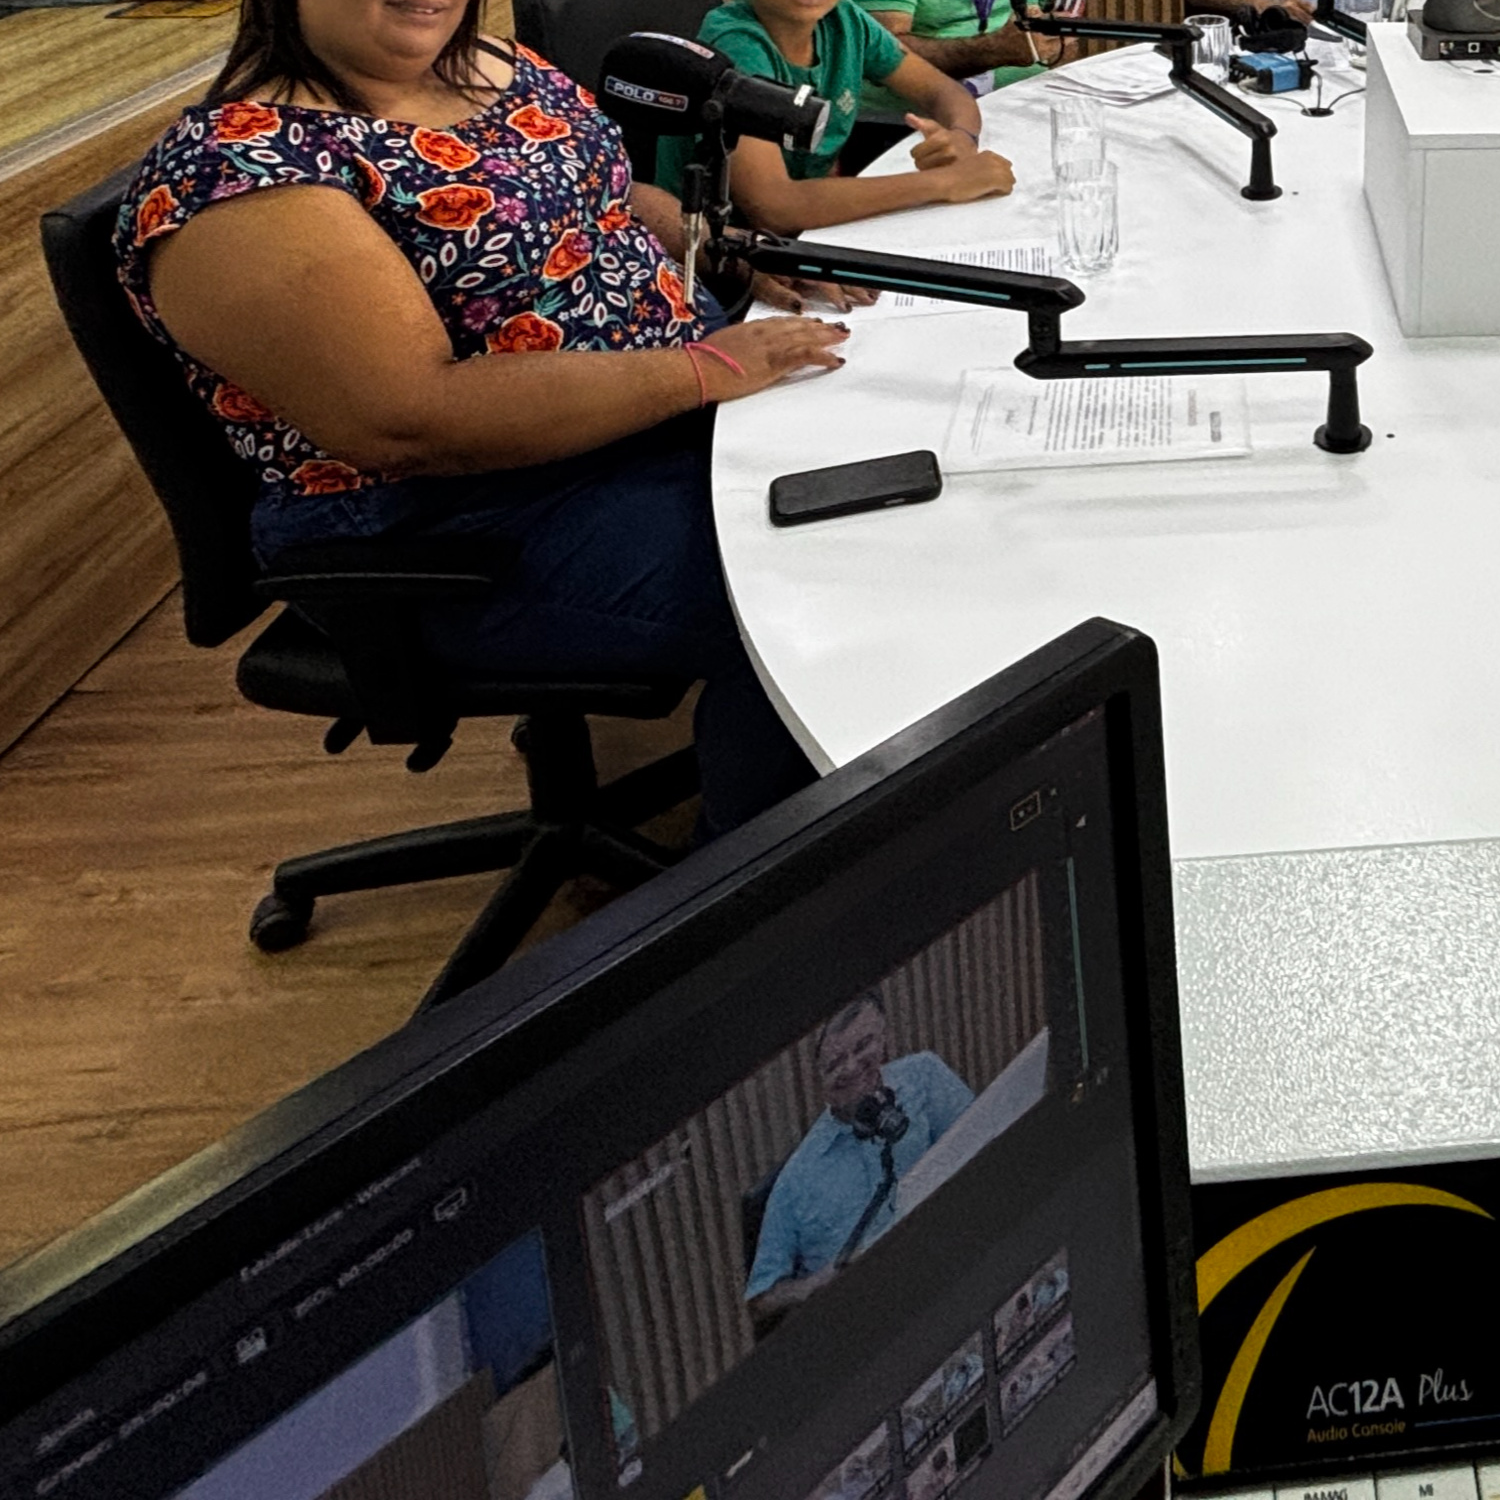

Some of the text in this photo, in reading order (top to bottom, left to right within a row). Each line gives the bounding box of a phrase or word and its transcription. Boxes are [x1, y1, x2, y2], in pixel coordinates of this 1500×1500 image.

[614, 82, 655, 102] POLO
[1306, 1368, 1473, 1419] AC12A Plus
[1307, 1418, 1406, 1443] Audio Console
